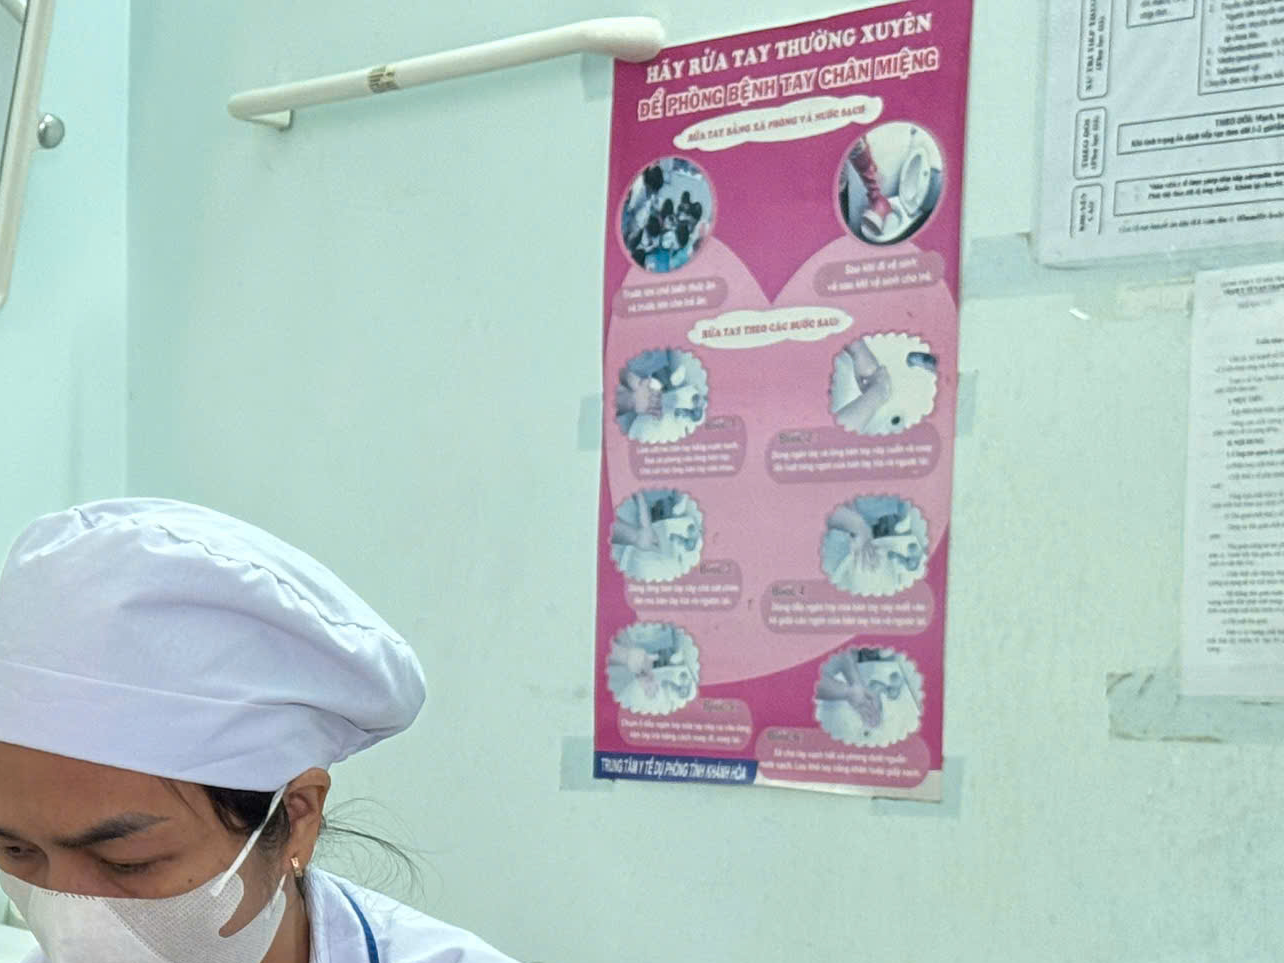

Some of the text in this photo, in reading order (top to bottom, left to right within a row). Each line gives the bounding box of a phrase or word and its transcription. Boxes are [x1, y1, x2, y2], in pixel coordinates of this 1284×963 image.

[638, 46, 940, 122] ĐỂ PHÒNG BỆNH TAY CHÂN MIỆNG
[646, 12, 933, 84] HÃY RỬA TAY THƯỜNG XUYÊN
[601, 757, 624, 773] TRUNG
